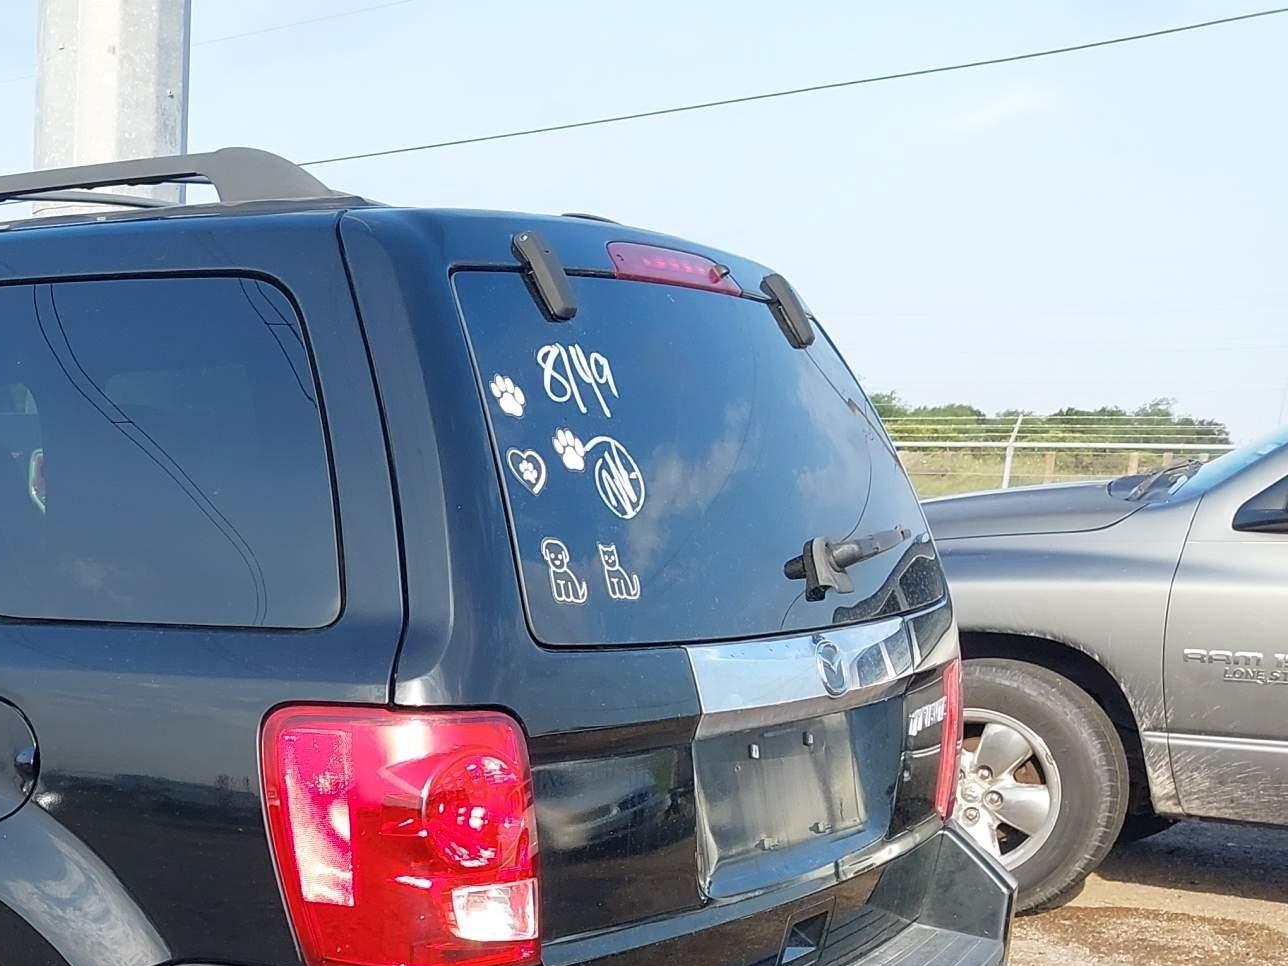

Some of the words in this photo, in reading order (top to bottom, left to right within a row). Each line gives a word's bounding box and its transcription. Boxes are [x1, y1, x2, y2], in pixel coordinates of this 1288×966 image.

[537, 342, 619, 417] 8149
[1183, 648, 1263, 666] RAM
[1223, 667, 1265, 679] LONE
